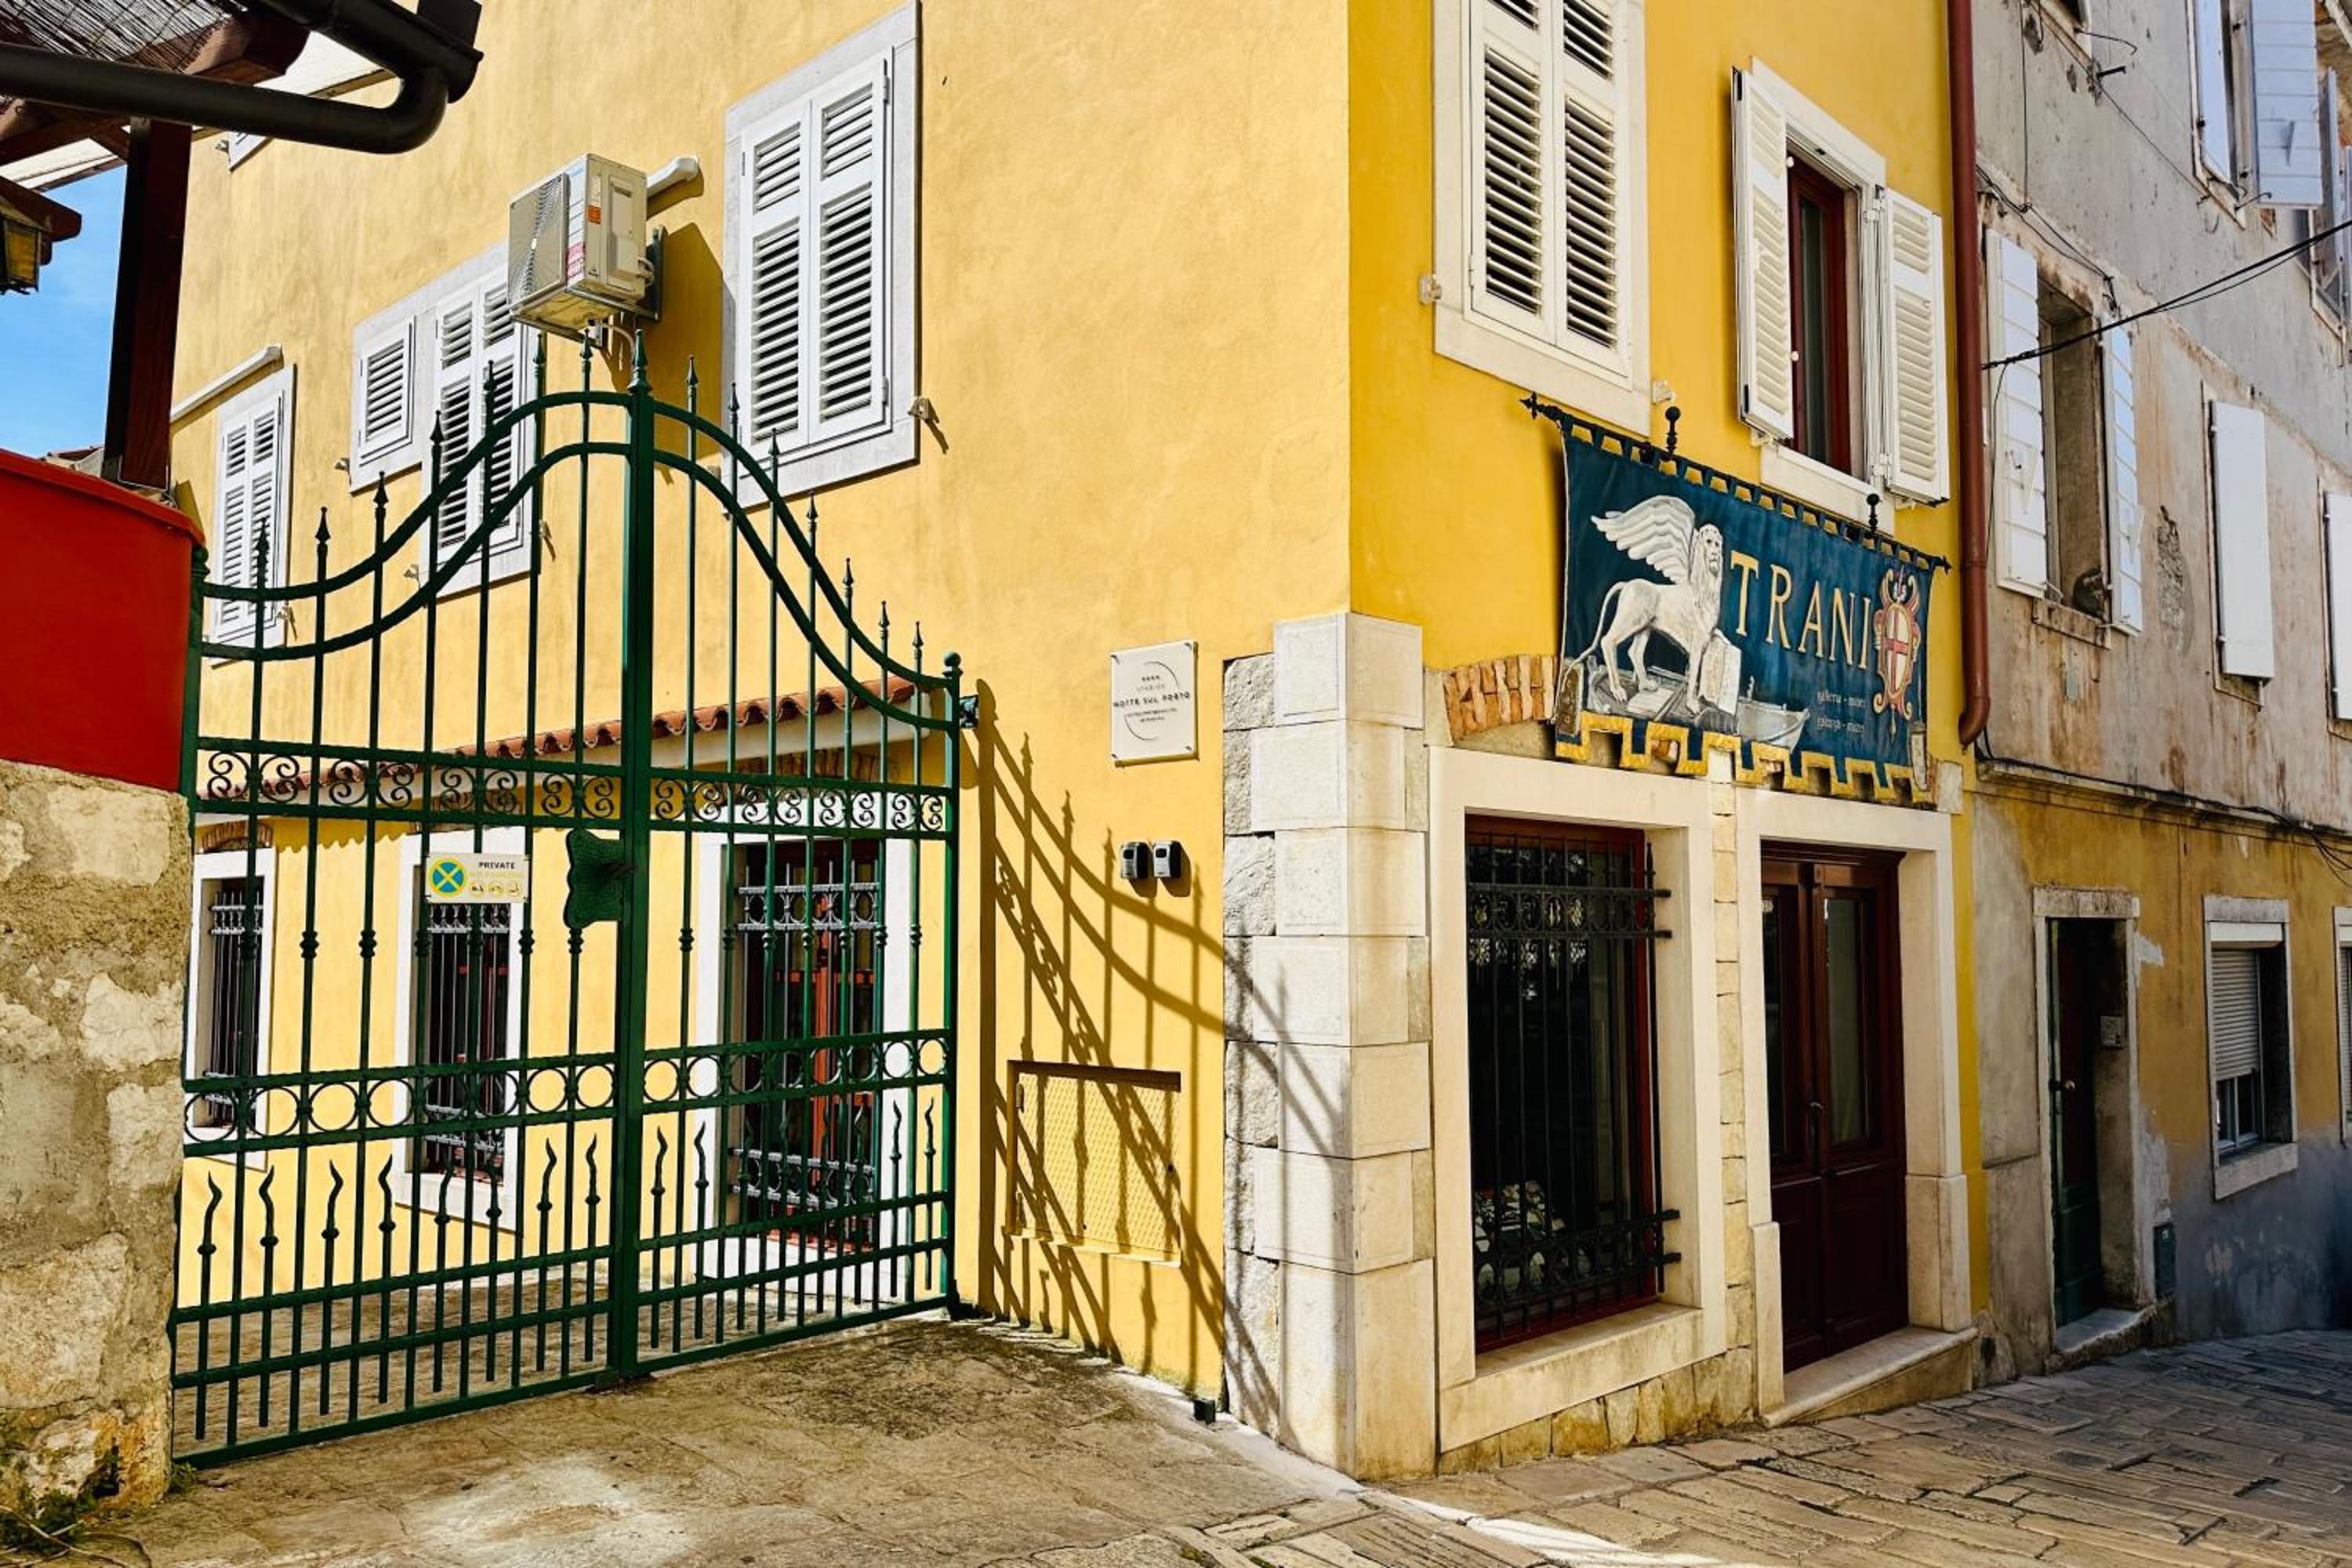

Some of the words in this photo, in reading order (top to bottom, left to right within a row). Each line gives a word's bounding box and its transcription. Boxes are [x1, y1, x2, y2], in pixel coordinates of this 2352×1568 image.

[1730, 550, 1871, 669] TRANI
[1113, 698, 1139, 708] NOTTE
[1162, 691, 1191, 702] PORTO
